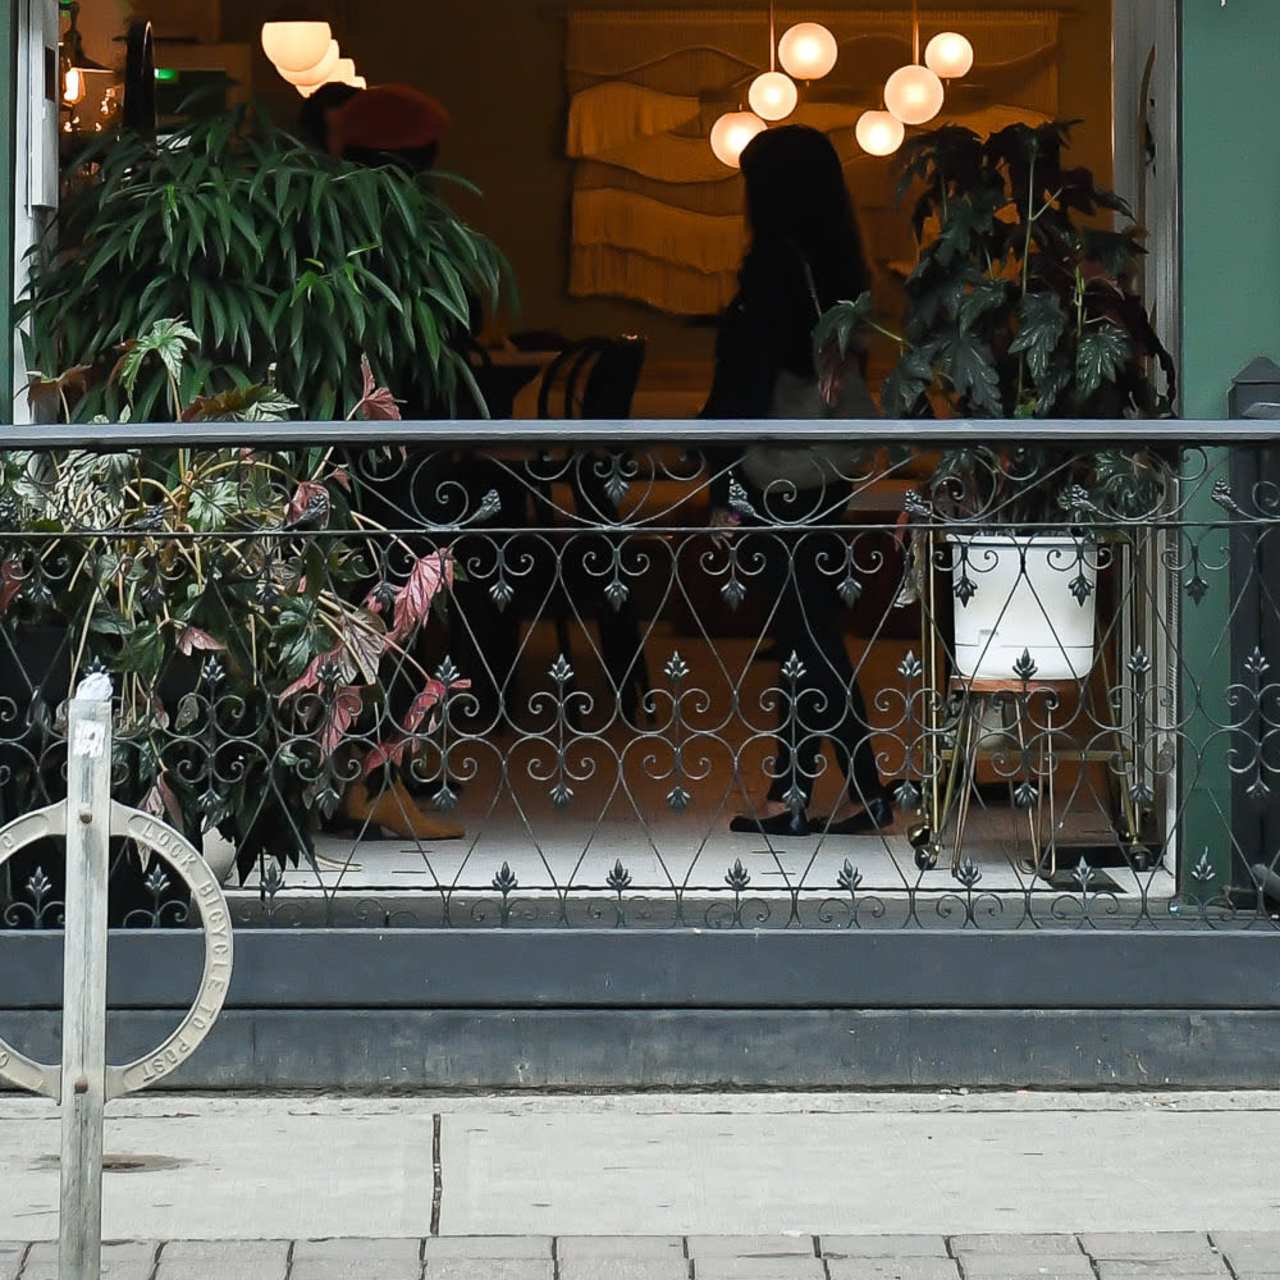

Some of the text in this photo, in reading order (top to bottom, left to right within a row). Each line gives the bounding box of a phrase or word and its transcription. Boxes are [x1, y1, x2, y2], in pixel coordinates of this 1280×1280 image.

[200, 880, 230, 993] BICYCLE
[191, 1003, 217, 1031] TO
[142, 1035, 191, 1082] POST
